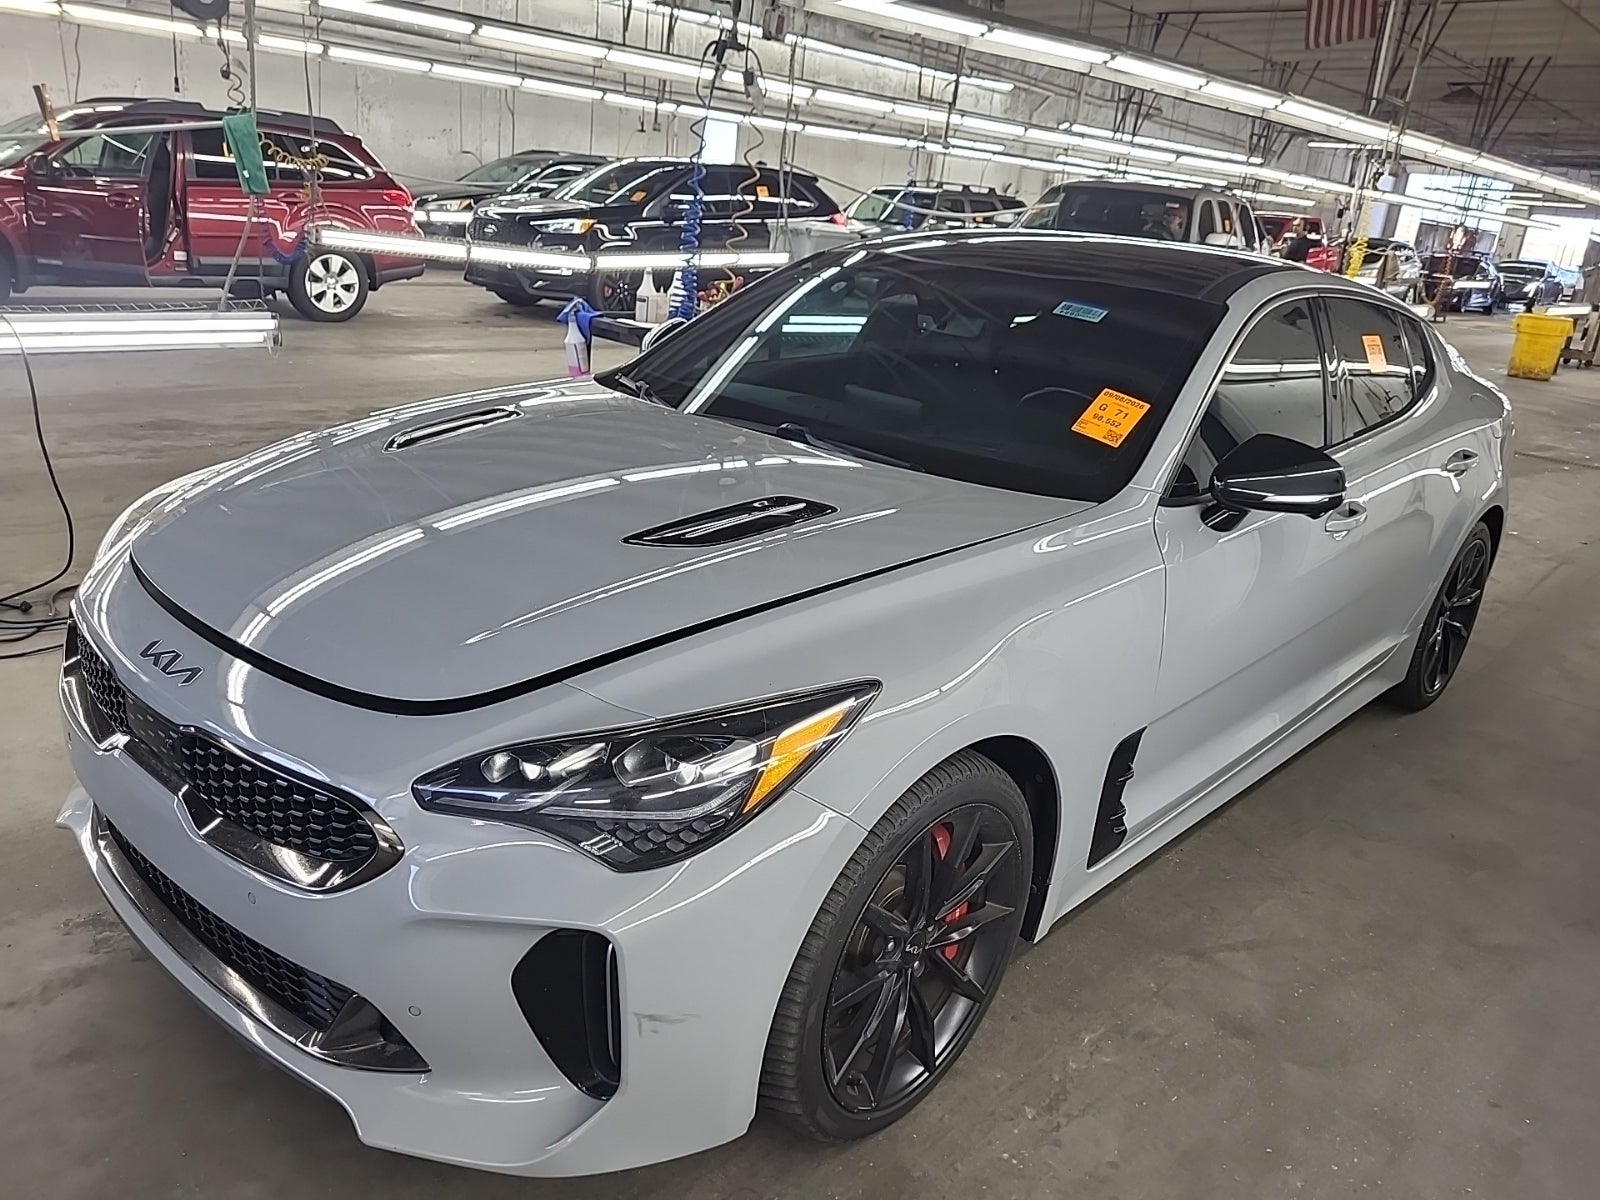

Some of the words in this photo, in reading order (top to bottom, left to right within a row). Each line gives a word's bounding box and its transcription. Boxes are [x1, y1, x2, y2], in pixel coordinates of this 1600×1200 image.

[1098, 403, 1109, 412] G
[1114, 408, 1130, 420] 71
[139, 639, 204, 686] KIA
